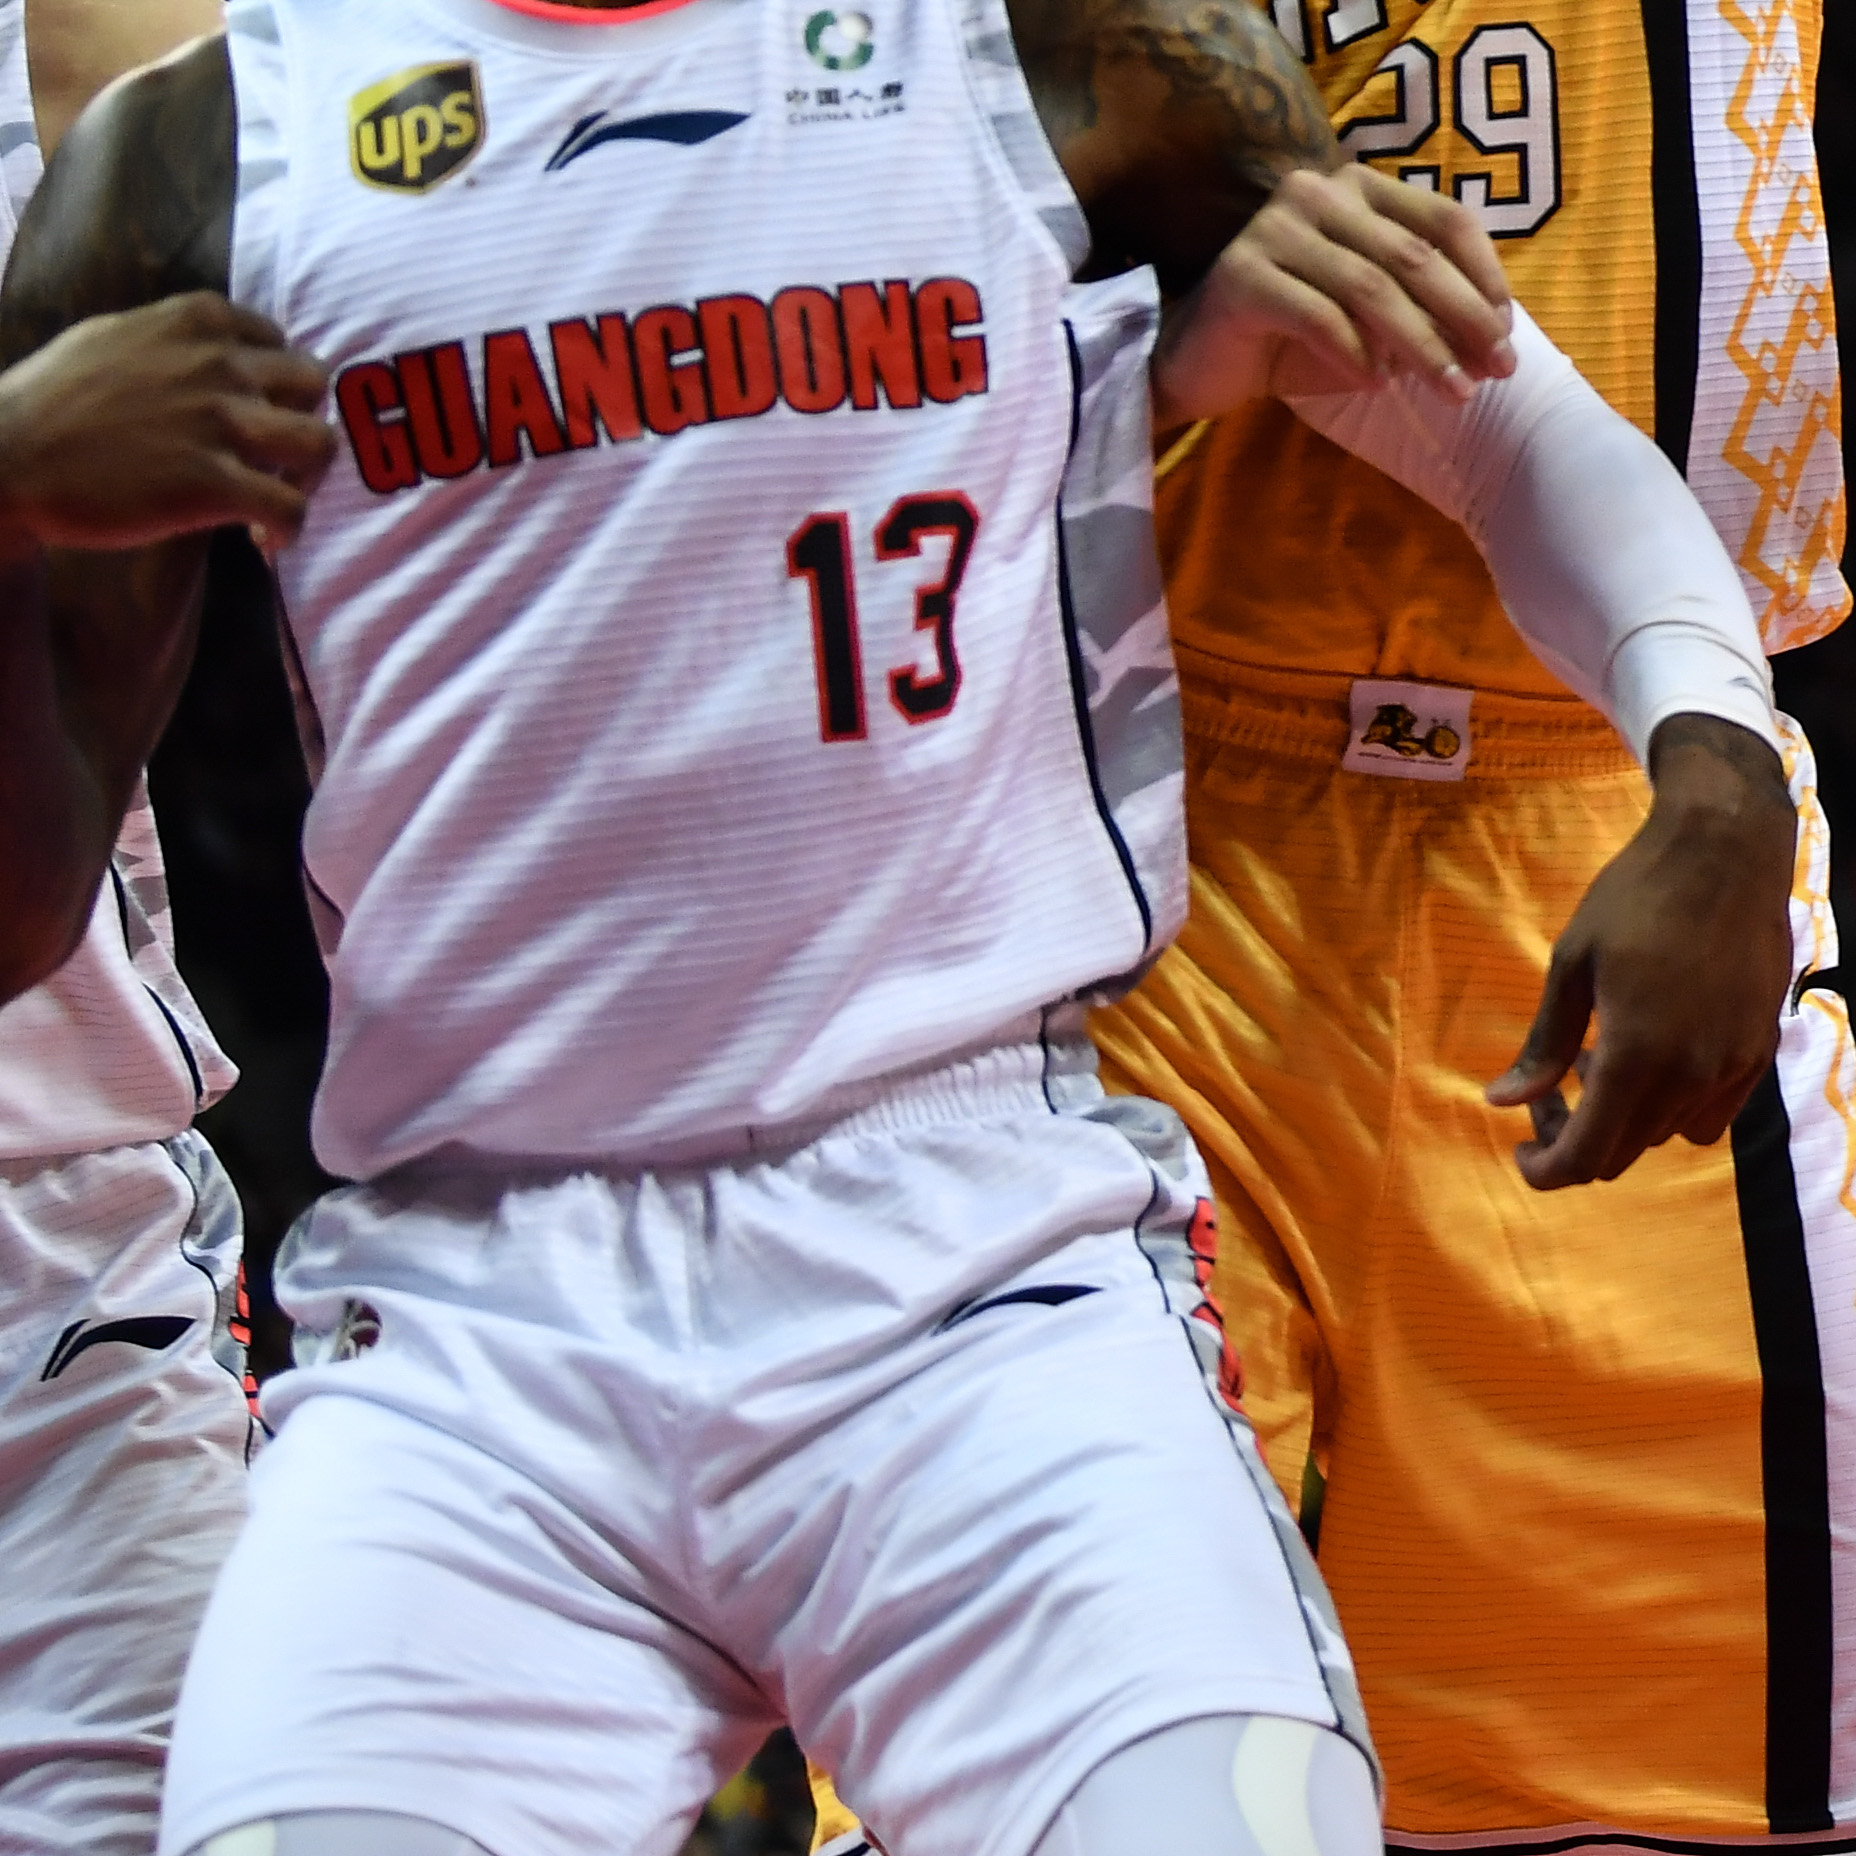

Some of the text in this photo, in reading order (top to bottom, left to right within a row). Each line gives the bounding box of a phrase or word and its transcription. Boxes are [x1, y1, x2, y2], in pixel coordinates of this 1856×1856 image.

[359, 89, 478, 181] ups
[1338, 21, 1564, 239] 29
[335, 276, 991, 495] GUANGDONG
[785, 488, 981, 744] 13
